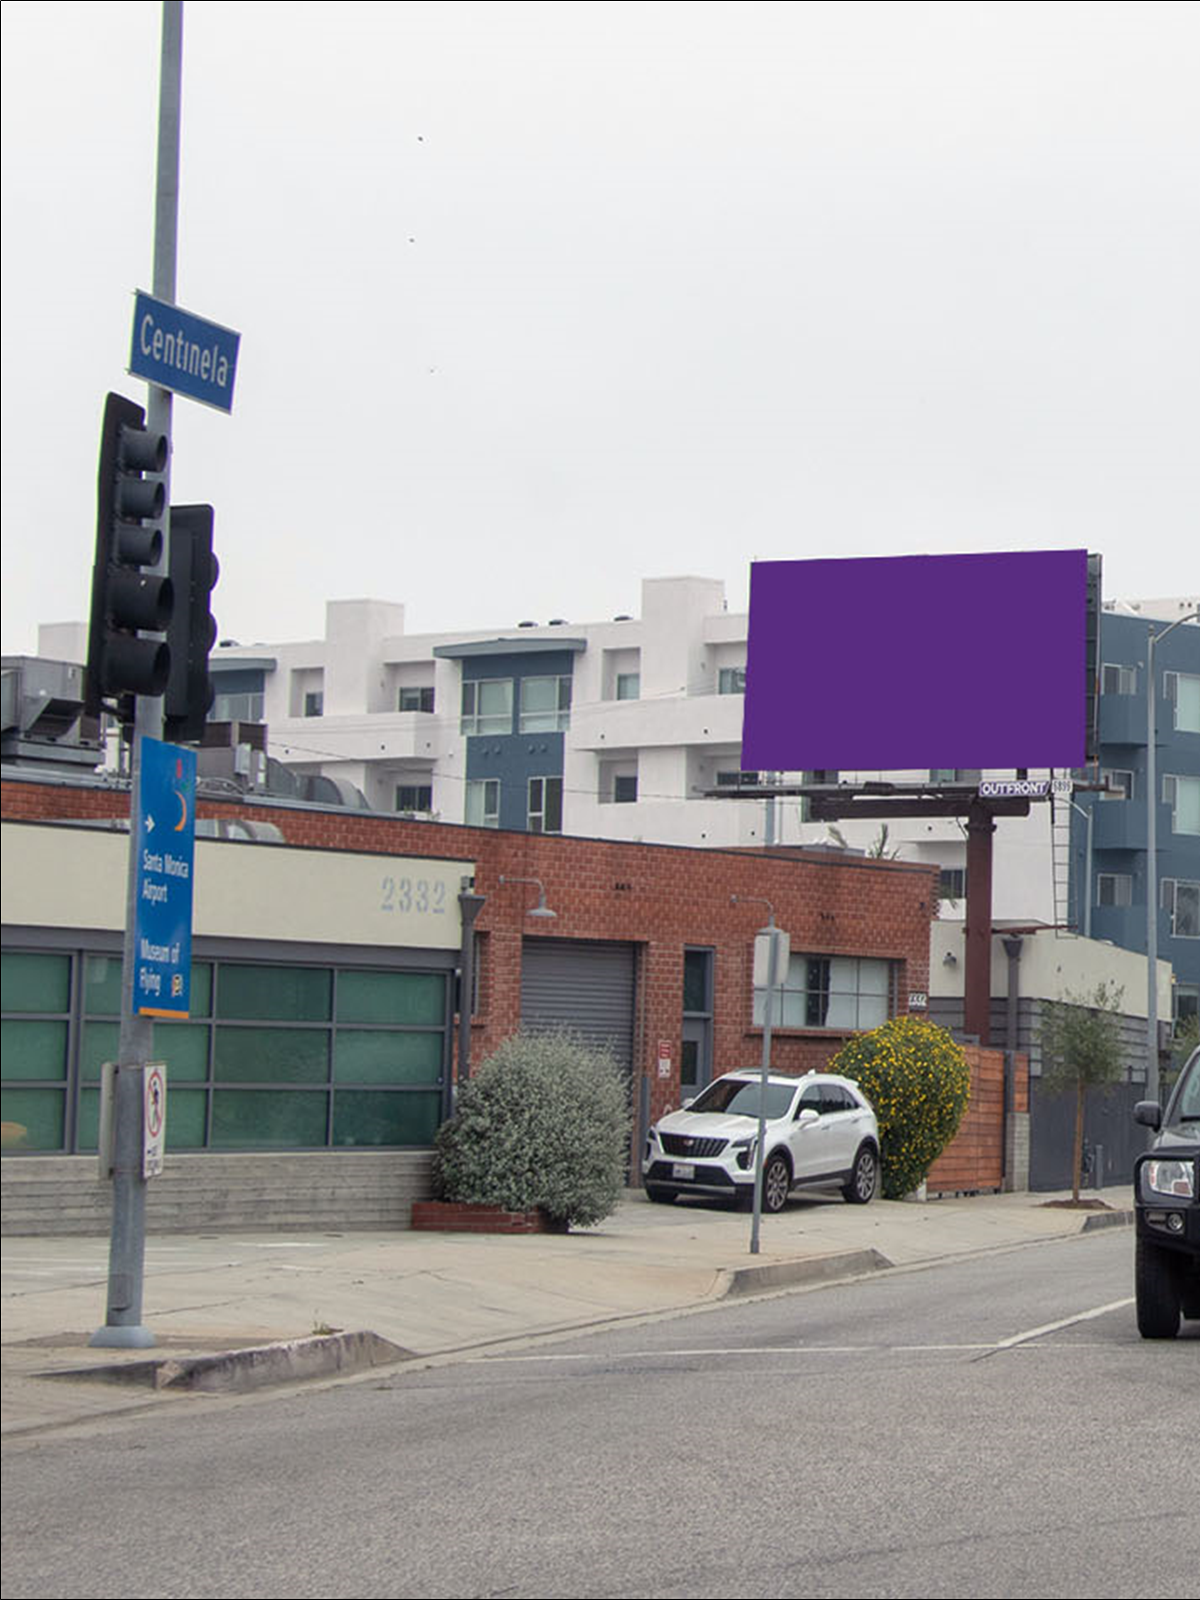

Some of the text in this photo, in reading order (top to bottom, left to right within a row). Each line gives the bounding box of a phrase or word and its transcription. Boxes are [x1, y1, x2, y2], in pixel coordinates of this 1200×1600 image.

[140, 313, 229, 388] Centinela
[982, 783, 1046, 795] OUTFRONT
[143, 849, 189, 878] Santa Monica
[142, 879, 168, 906] Airport
[381, 875, 446, 914] 2332
[140, 938, 180, 964] Museum of
[139, 967, 161, 997] Flying
